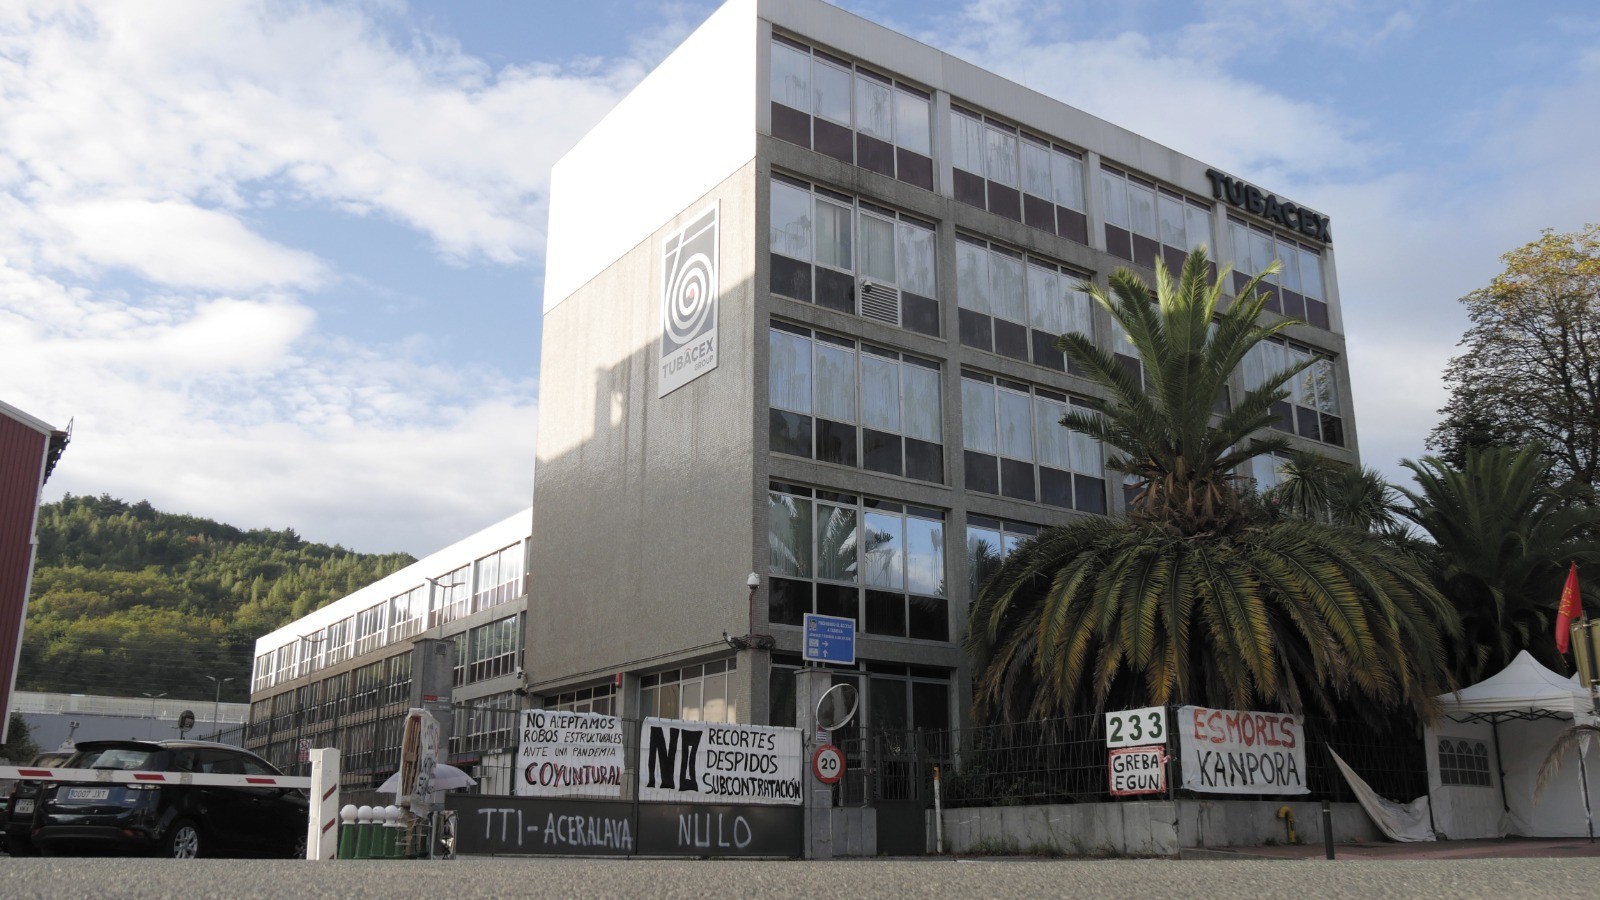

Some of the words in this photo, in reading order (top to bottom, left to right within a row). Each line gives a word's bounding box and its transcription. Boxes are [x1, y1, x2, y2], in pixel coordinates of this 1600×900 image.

[694, 354, 714, 371] GROUP
[526, 713, 545, 729] NO
[550, 715, 615, 730] ACEPTAMOS
[1109, 712, 1163, 743] 233
[1193, 709, 1296, 748] ESMORIS
[524, 729, 558, 743] ROBOS
[564, 731, 622, 744] ESTRUCTURALES
[708, 728, 776, 750] RECORTES
[523, 746, 549, 757] ANTE
[555, 747, 568, 757] UNA
[573, 747, 616, 757] PANDEMIA
[646, 726, 703, 792] NO
[706, 750, 778, 774] DESPIDOS
[525, 762, 621, 787] COYUNTURAL
[821, 758, 837, 770] 20
[1113, 754, 1159, 773] GREBA
[1197, 750, 1301, 787] KANPORA
[702, 773, 801, 799] SUBCONTRATACIÓN
[1115, 774, 1160, 791] EGUN
[679, 813, 752, 848] NULO
